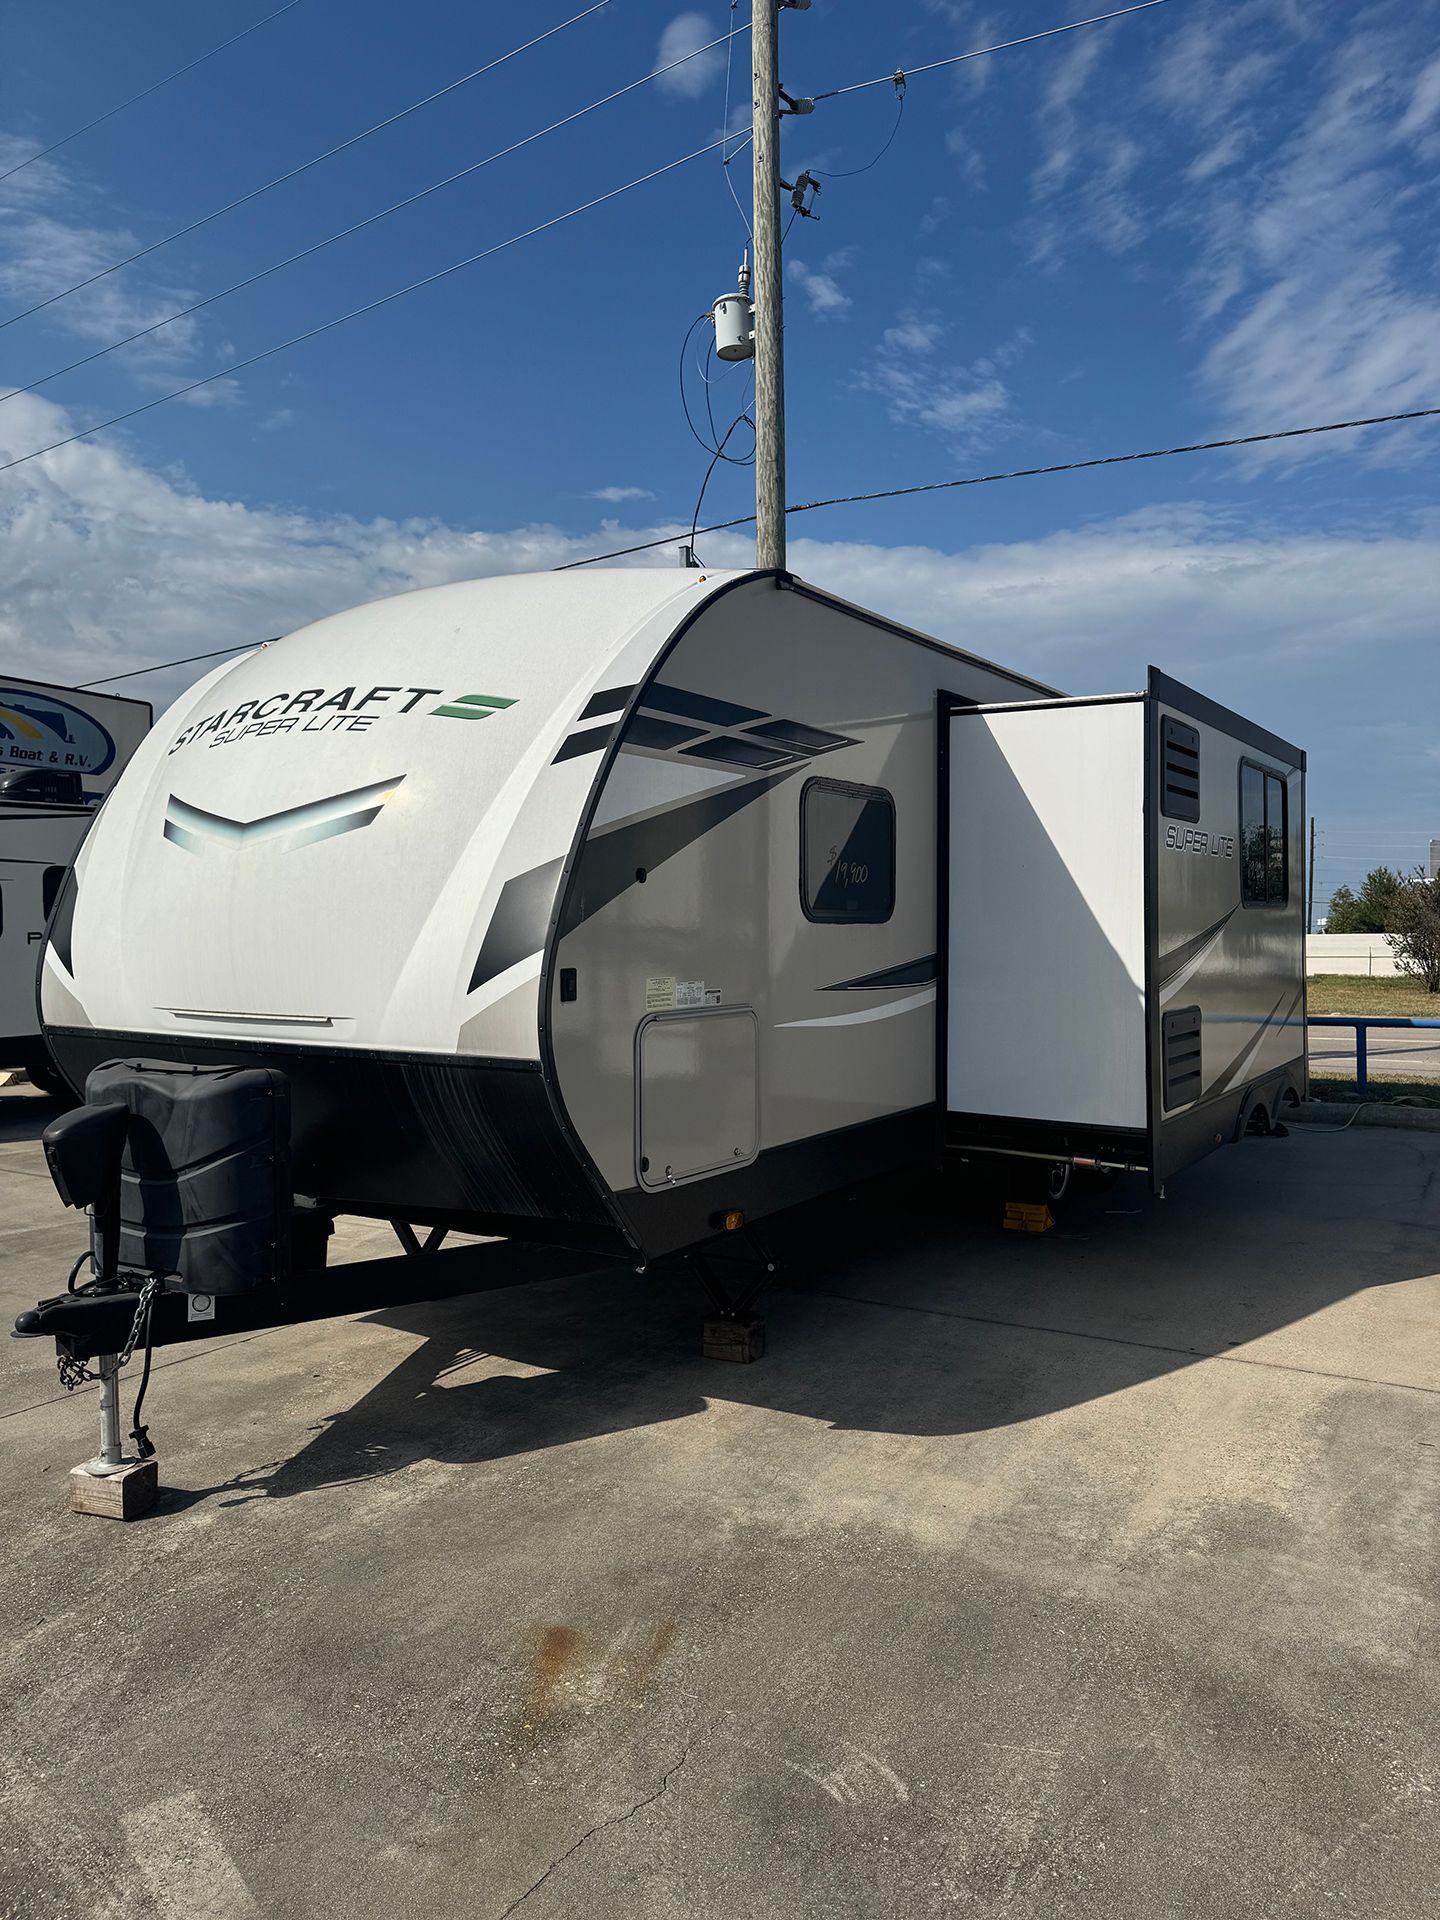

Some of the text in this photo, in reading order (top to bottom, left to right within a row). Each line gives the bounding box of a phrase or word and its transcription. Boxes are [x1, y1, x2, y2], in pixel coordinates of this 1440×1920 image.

[167, 686, 444, 756] STARCRAFT
[208, 715, 380, 749] SUPER LITE
[9, 745, 44, 761] Boat
[49, 751, 59, 764] &
[64, 753, 92, 768] R.V.
[1166, 824, 1234, 859] SUPER LITE
